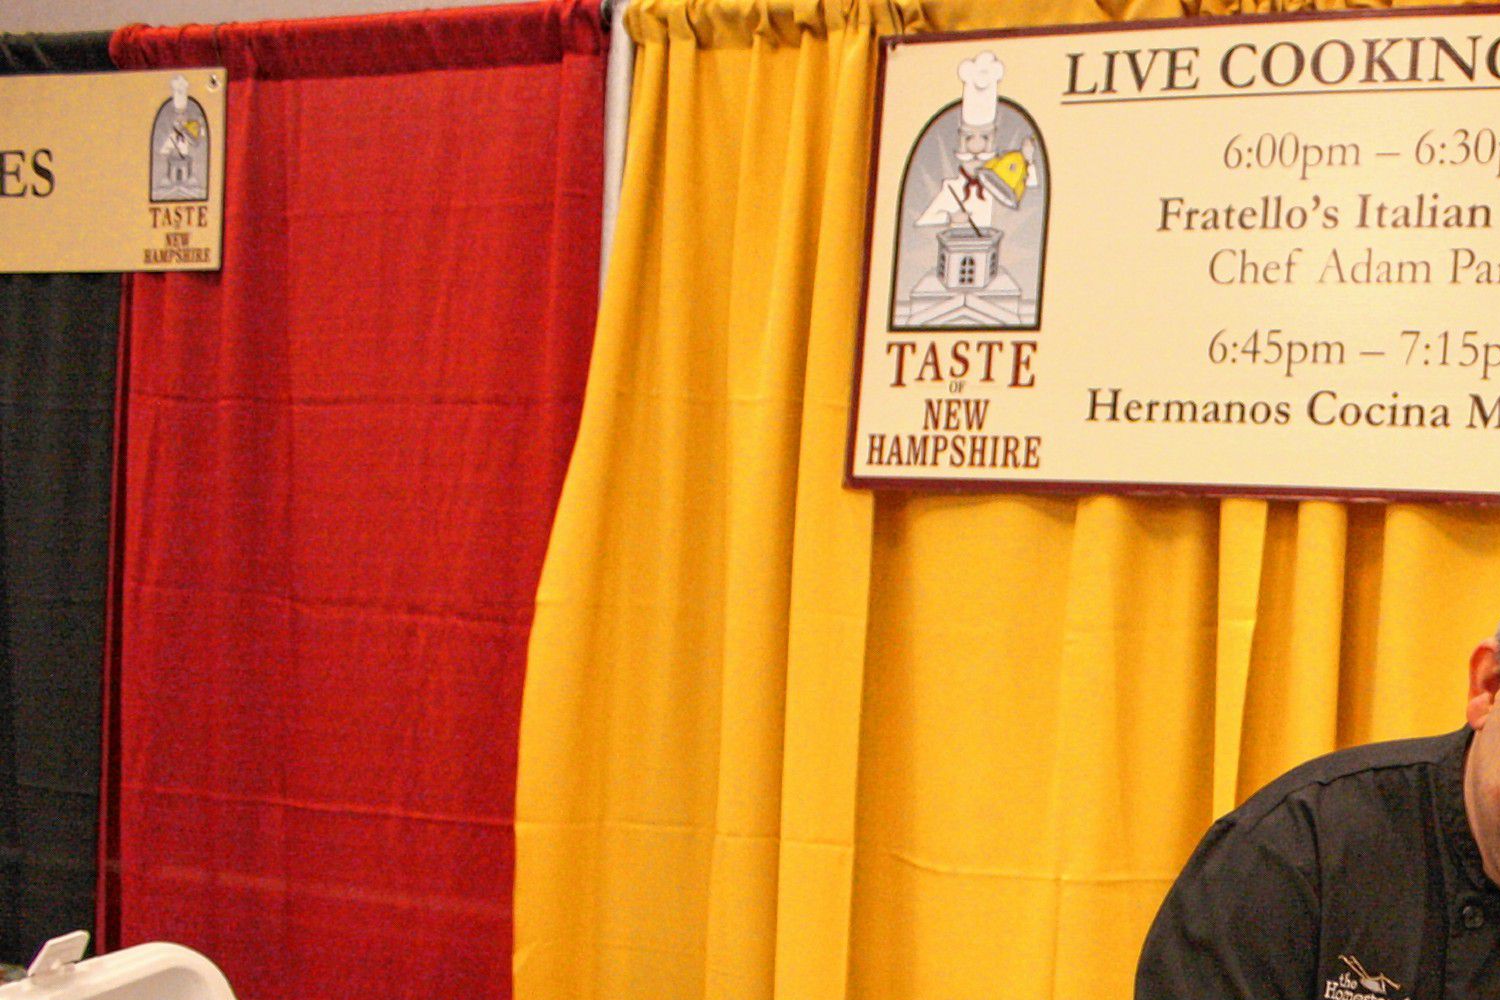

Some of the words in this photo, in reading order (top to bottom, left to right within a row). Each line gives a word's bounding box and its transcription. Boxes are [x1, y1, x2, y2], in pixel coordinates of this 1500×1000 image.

[1063, 47, 1200, 95] LIVE
[0, 148, 56, 198] ES
[1223, 131, 1361, 181] 6:00pm
[149, 206, 208, 229] TASTE
[1157, 193, 1340, 232] Fratello’s
[1355, 192, 1491, 229] Italian
[143, 248, 210, 265] HAMPSHIRE
[165, 232, 190, 247] NEW
[1208, 247, 1303, 285] Chef
[1317, 247, 1432, 284] Adam
[886, 339, 1038, 388] TASTE
[1208, 328, 1346, 378] 6:45pm
[922, 398, 991, 431] NEW
[1085, 386, 1292, 425] Hermanos
[1306, 390, 1451, 428] Cocina
[866, 433, 1042, 469] HAMPSHIRE
[1338, 971, 1359, 990] the
